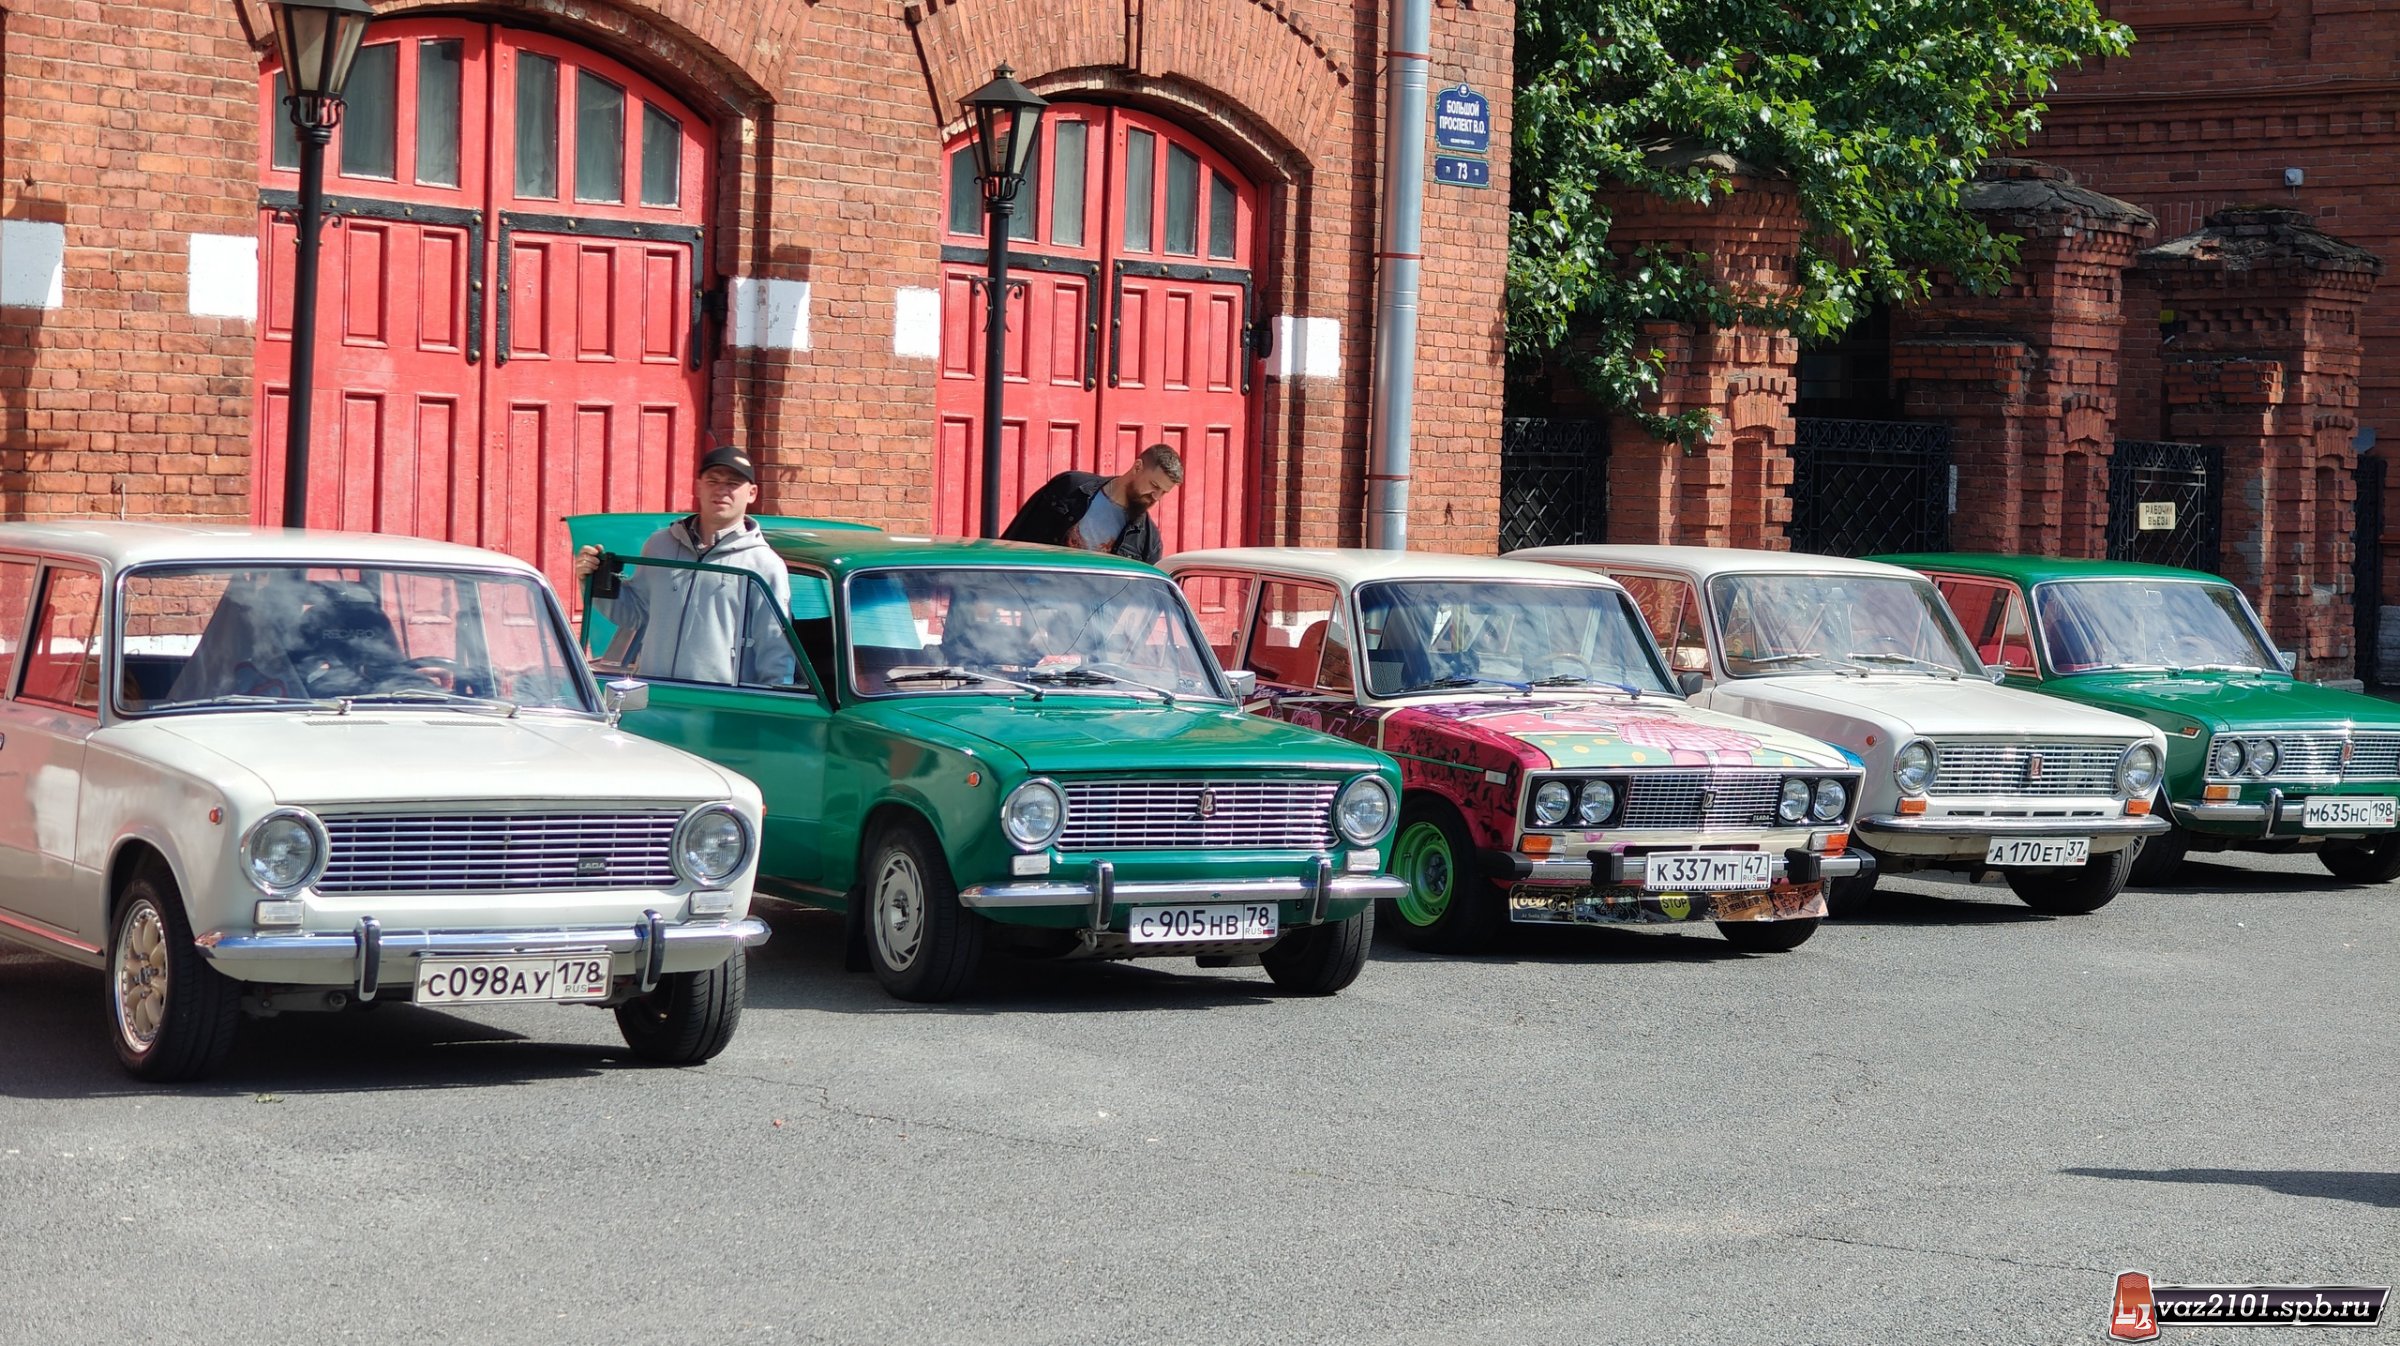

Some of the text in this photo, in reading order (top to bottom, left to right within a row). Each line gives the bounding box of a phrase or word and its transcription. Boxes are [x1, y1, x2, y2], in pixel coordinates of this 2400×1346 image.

[1446, 100, 1480, 117] БОЛЬШОЙ
[1439, 116, 1487, 135] ПРОСПЕКТ В.О.
[1457, 162, 1468, 180] 73
[2309, 802, 2393, 822] М635НС 198
[1992, 841, 2084, 862] А170ЕТ 37
[1657, 856, 1763, 882] К337МТ 47
[1662, 897, 1688, 910] STOP
[1140, 906, 1270, 938] С905НВ 78
[1245, 927, 1263, 935] RUS
[428, 961, 601, 997] С098АУ 178
[564, 984, 588, 993] RUS
